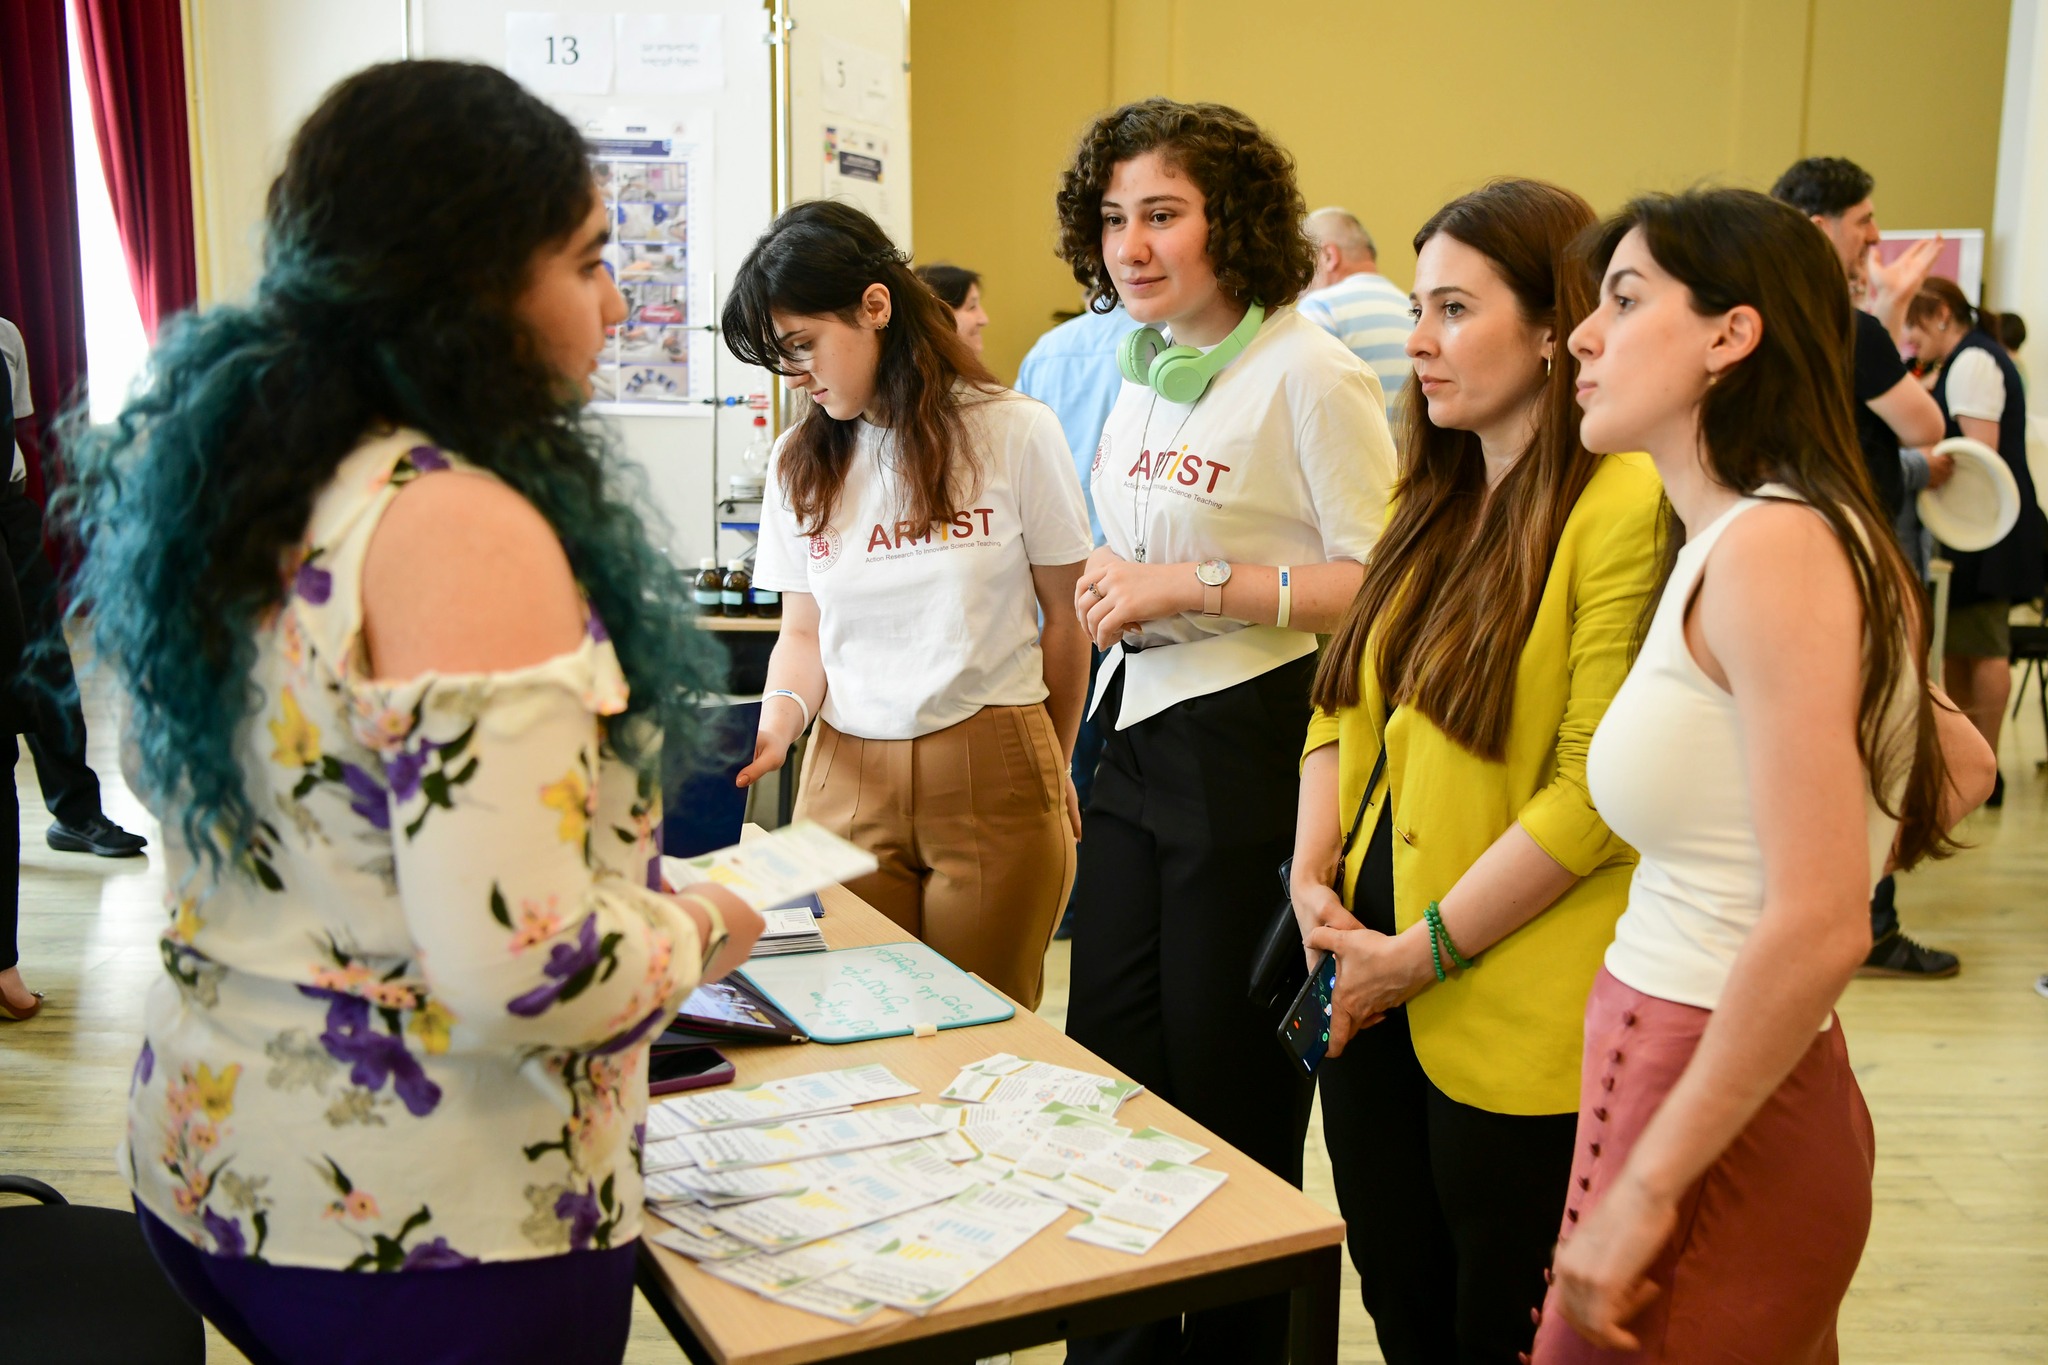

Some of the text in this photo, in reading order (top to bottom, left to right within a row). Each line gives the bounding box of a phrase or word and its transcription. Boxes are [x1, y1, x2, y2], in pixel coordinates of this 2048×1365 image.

[545, 36, 580, 66] 13
[1168, 486, 1193, 500] Science
[1194, 494, 1223, 510] Teaching
[865, 555, 885, 564] Action
[885, 551, 915, 561] Research
[923, 545, 949, 555] Innovate
[950, 541, 975, 550] Science
[976, 540, 1002, 548] Teaching
